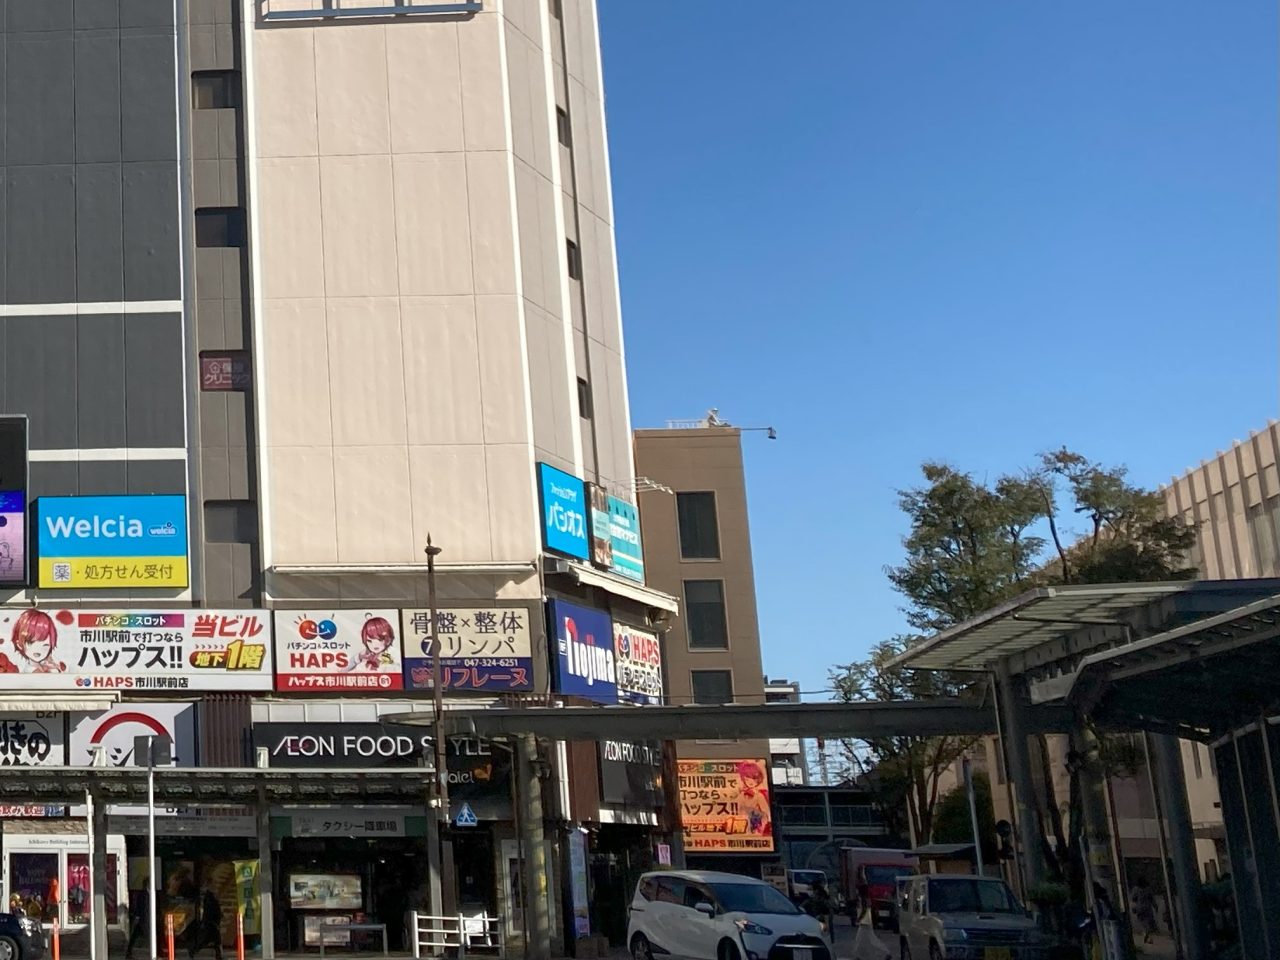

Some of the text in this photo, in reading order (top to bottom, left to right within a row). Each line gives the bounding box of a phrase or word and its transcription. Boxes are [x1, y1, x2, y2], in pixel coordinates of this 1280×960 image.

[46, 515, 176, 538] Welcia welcia
[95, 616, 166, 625] パチンコ・スロット
[192, 615, 263, 638] 当ビル
[80, 630, 183, 643] 市川駅前で打つなら
[448, 636, 516, 657] リンパ
[78, 643, 183, 669] ハップス!!
[194, 640, 266, 670] 地下1階
[290, 652, 349, 668] HAPS
[633, 635, 660, 666] HAPS
[94, 677, 188, 688] HAPS 市川駅前店
[288, 676, 378, 687] ハップス市川駅前店
[343, 736, 414, 756] FOOD
[421, 736, 492, 756] SYLE
[694, 839, 726, 848] HAPS
